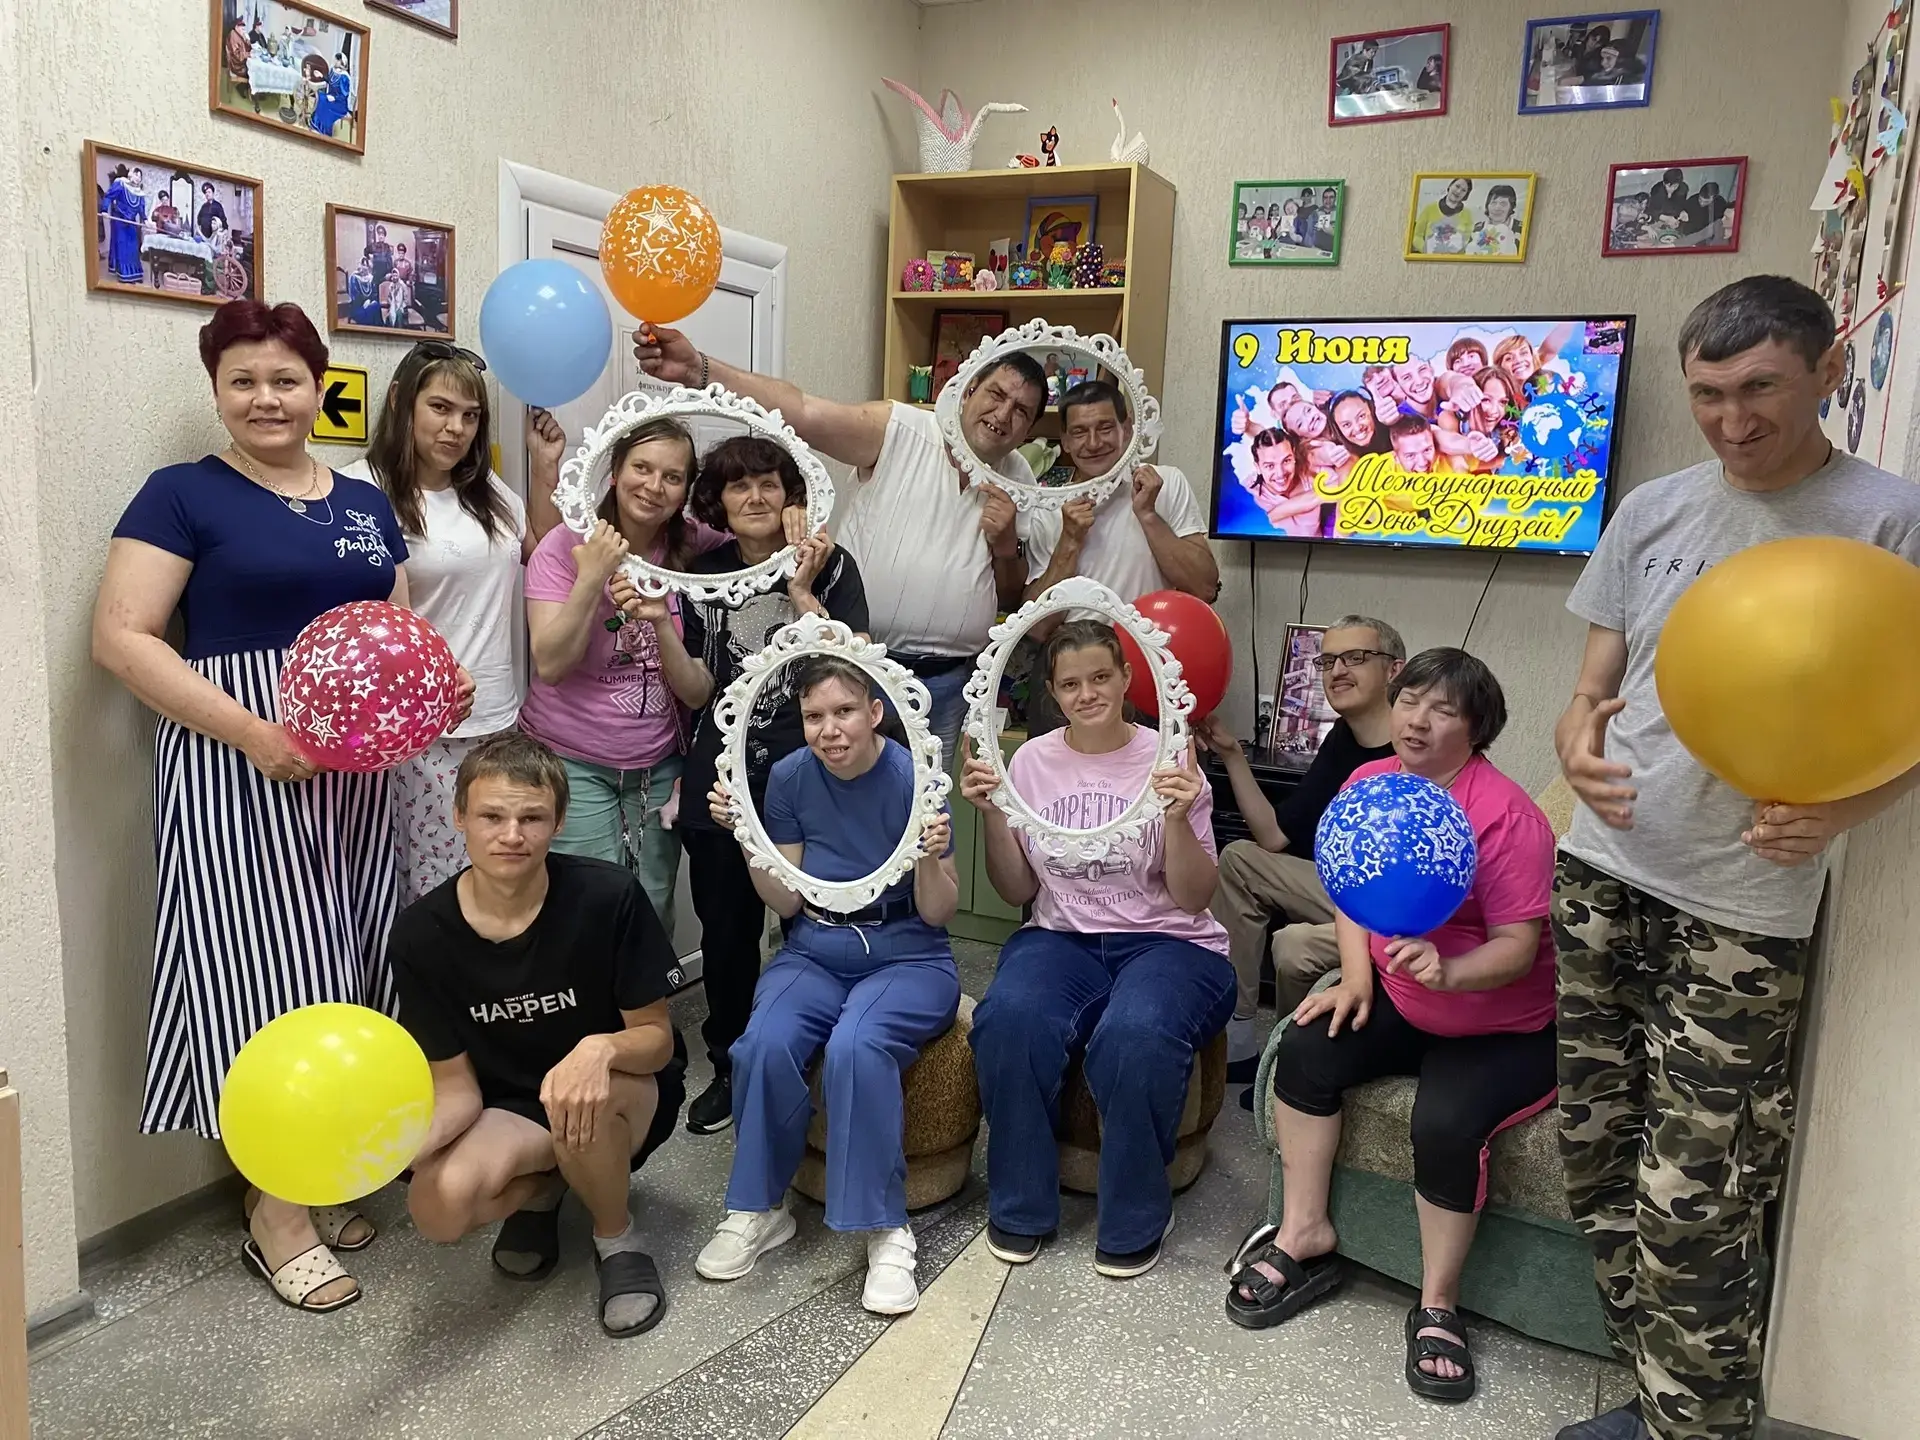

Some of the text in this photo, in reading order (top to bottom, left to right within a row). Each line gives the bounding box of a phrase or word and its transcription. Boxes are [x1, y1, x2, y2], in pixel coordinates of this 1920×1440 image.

[1234, 329, 1411, 369] 9 Июня
[1317, 455, 1593, 510] Международный
[1340, 496, 1577, 547] День Друзей!
[598, 674, 643, 684] SUMMER
[1095, 889, 1144, 907] EDITION
[469, 988, 577, 1023] HAPPEN
